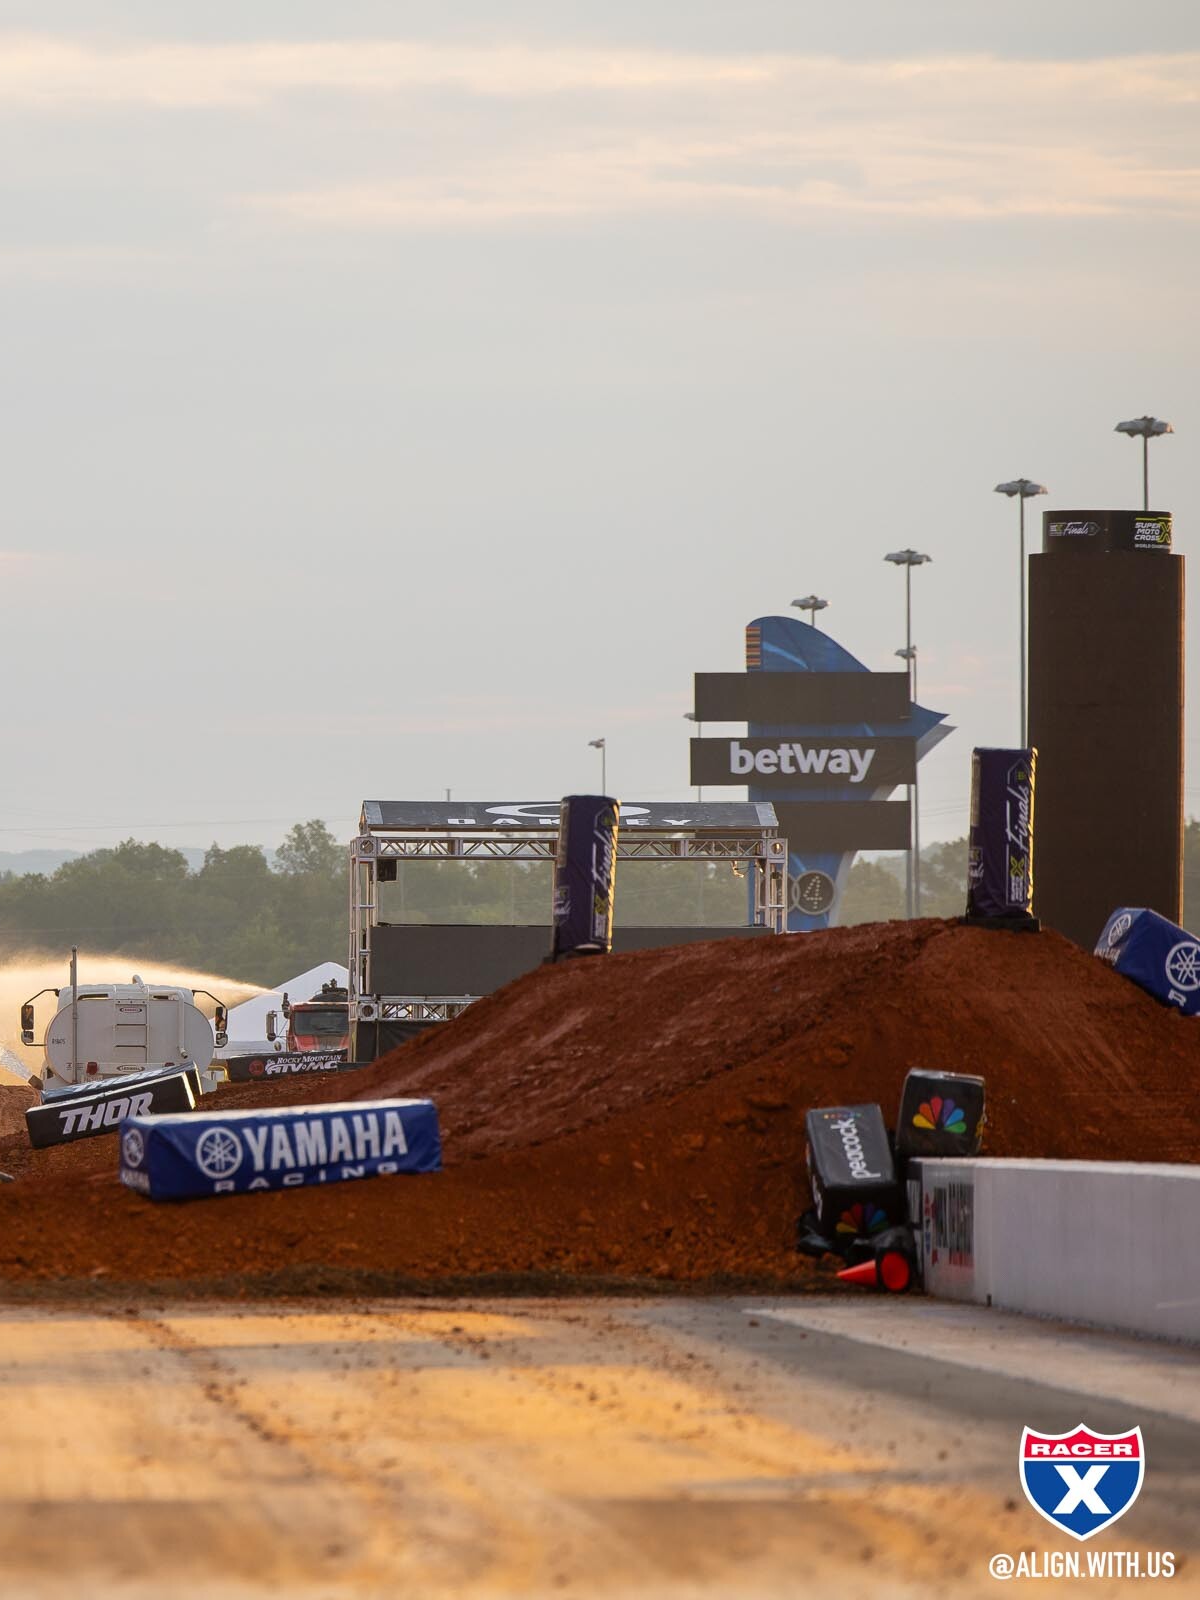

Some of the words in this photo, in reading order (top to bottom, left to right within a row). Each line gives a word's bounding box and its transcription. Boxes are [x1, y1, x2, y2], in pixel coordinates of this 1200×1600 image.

[730, 741, 875, 783] betway
[447, 818, 692, 826] OAKEY
[803, 876, 823, 909] 4
[277, 1056, 301, 1064] ROCKY
[302, 1055, 342, 1063] MOUNTAIN
[59, 1092, 154, 1135] THOR
[243, 1111, 408, 1172] YAMAHA
[831, 1118, 881, 1180] peacock
[215, 1161, 398, 1193] RACING
